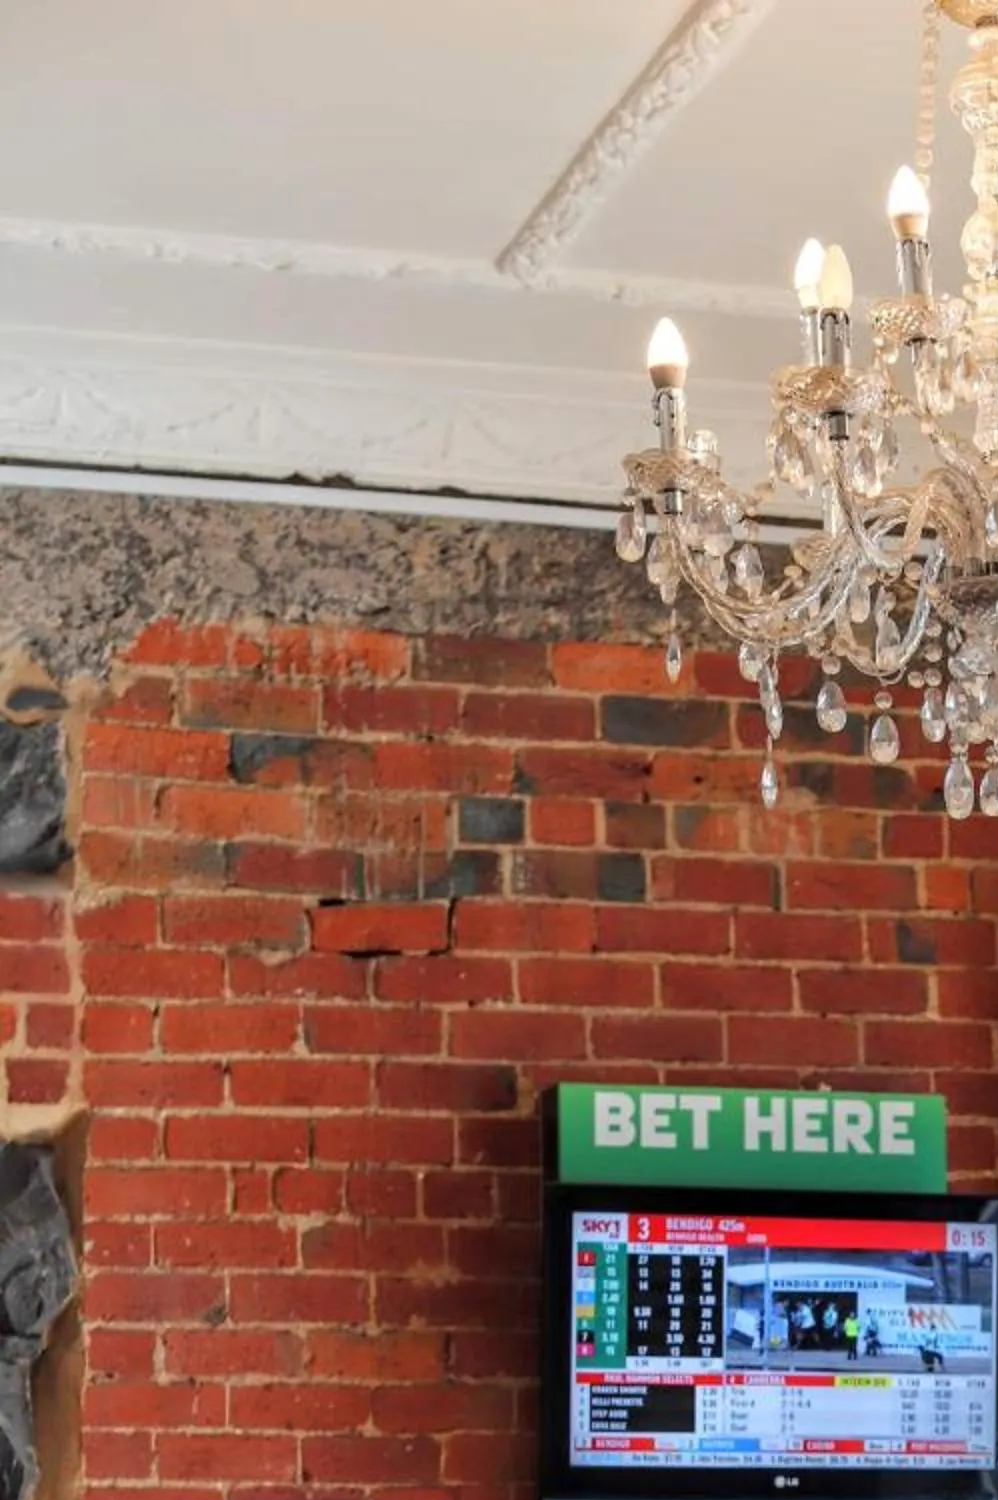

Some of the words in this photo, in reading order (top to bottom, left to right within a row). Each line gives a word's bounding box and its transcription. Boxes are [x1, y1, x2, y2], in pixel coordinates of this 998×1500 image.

[594, 1091, 723, 1150] BET
[744, 1096, 916, 1155] HERE
[637, 1217, 650, 1240] 3
